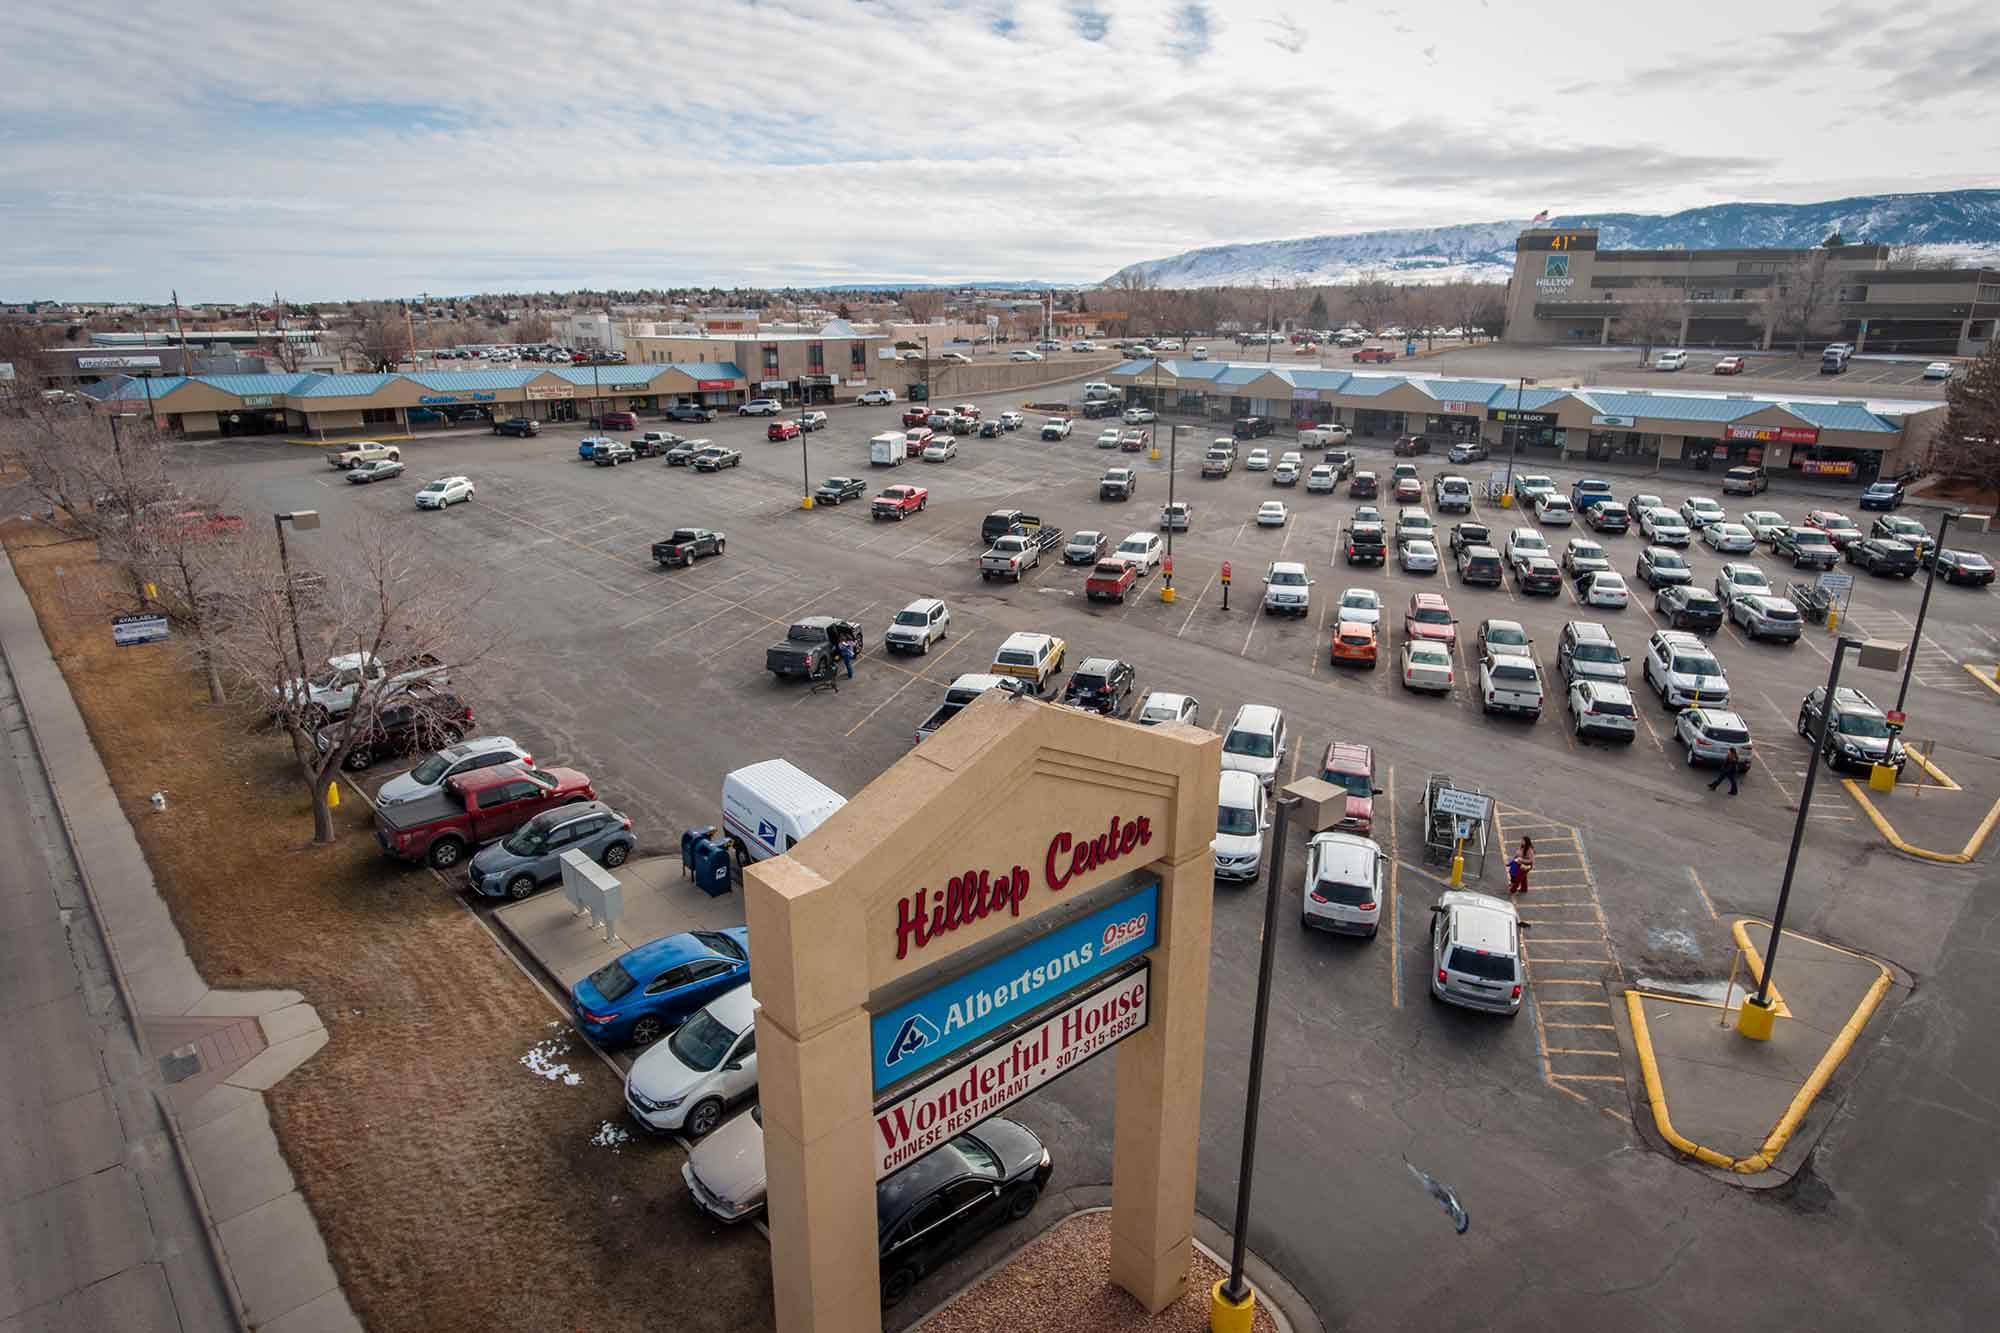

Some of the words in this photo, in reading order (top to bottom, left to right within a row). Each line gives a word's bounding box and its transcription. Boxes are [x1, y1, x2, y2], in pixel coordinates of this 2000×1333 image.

[1536, 278, 1574, 287] HILLTOP
[1541, 287, 1567, 296] BANK
[896, 865, 1030, 960] Hilltop
[1045, 815, 1152, 891] Center
[943, 940, 1094, 1036] Albertsons
[1103, 913, 1148, 946] Osco
[877, 1026, 1050, 1150] Wonderful
[1060, 983, 1145, 1049] House
[883, 1128, 943, 1171] CHINESE
[947, 1074, 1031, 1133] RESTAURANT
[1056, 1012, 1138, 1070] 307-315-6832
